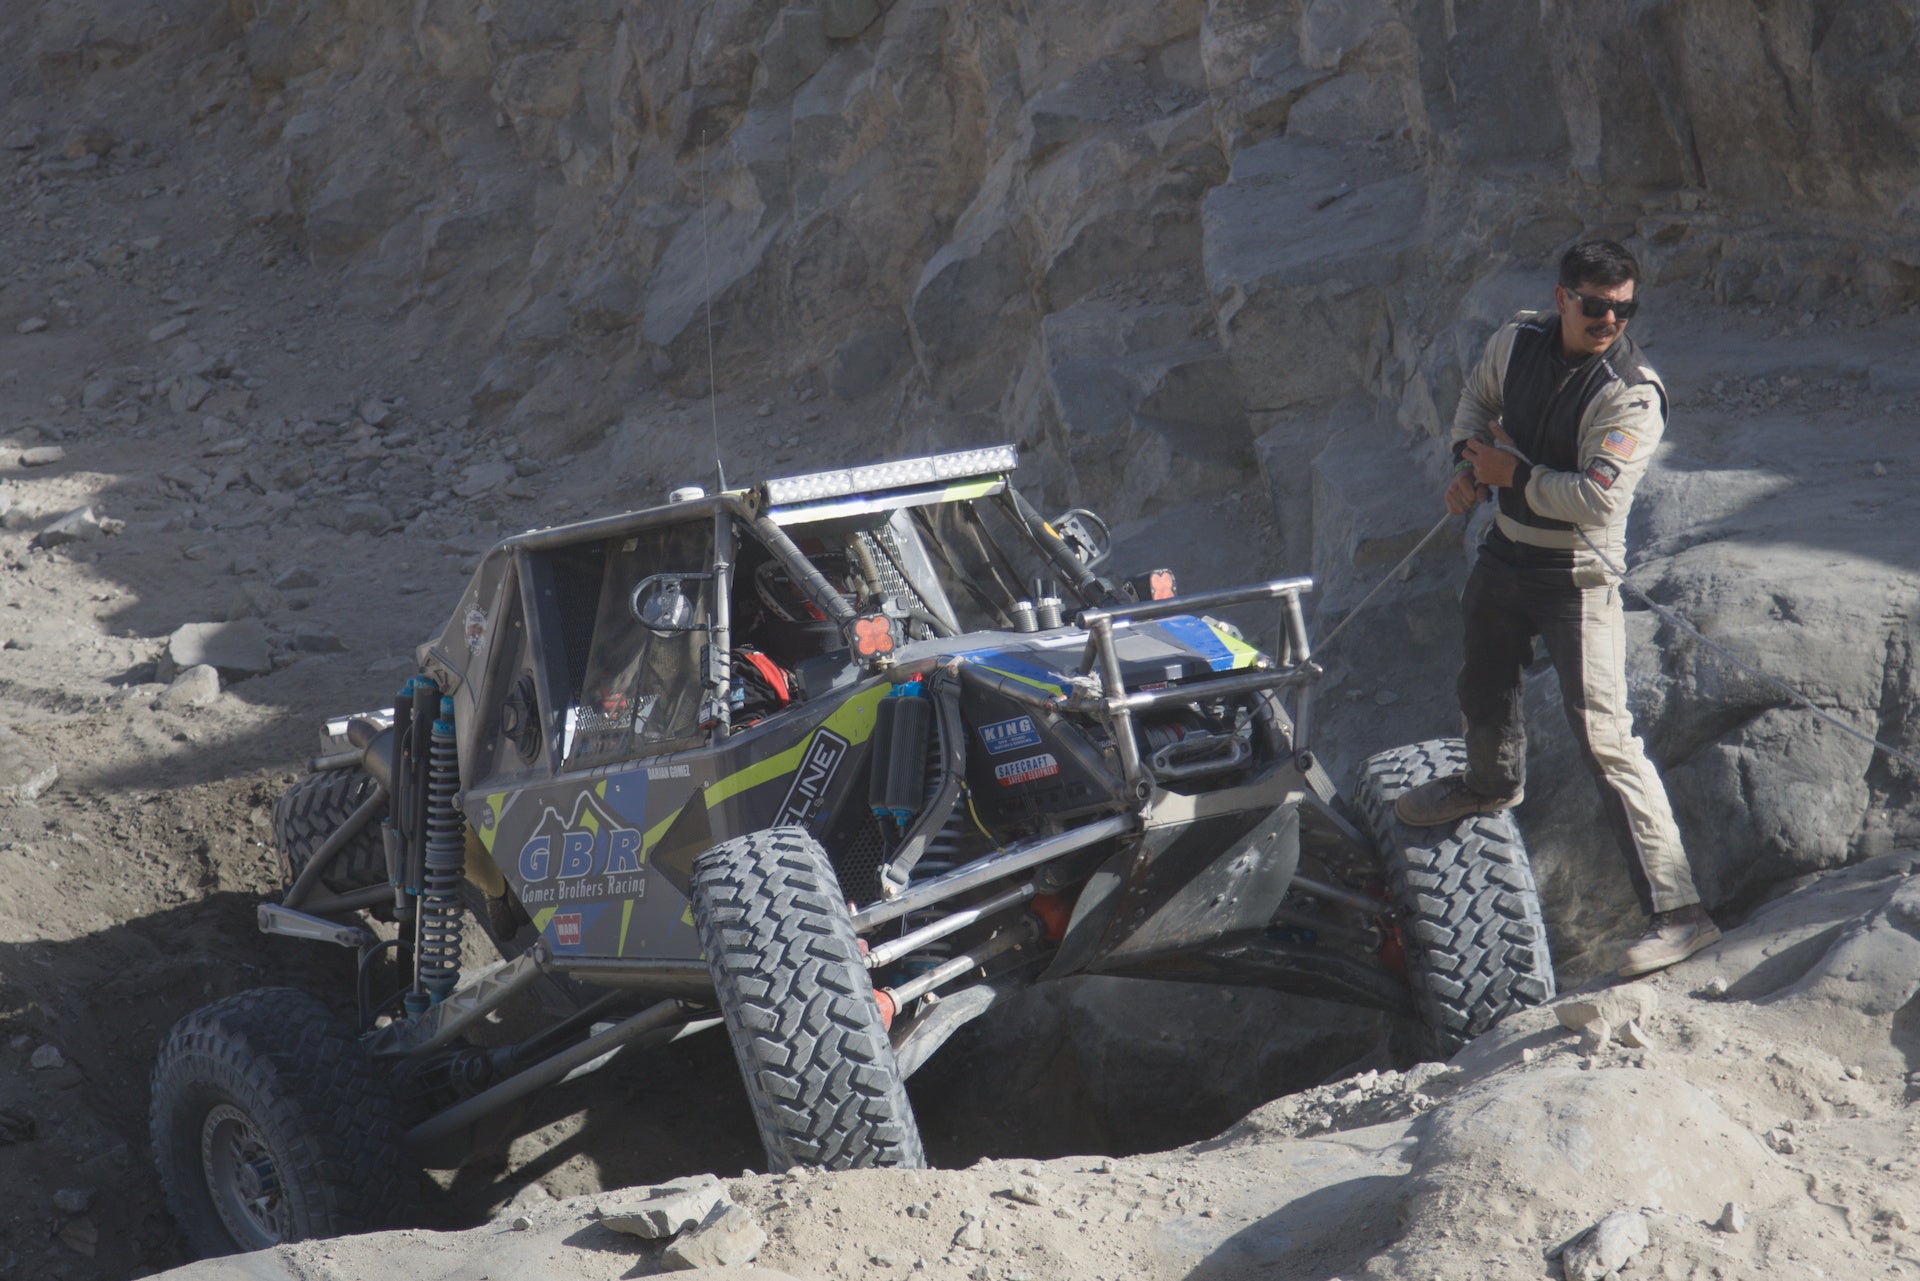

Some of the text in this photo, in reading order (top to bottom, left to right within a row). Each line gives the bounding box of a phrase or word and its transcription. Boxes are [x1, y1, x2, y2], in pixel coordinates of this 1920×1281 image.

[984, 719, 1031, 741] KING
[669, 764, 691, 778] GOMEZ
[998, 756, 1049, 778] SAFECRAFT
[1008, 765, 1058, 785] SAFETY EQUIPMENT
[518, 828, 644, 883] GBR
[522, 875, 646, 903] Gomez Brothers Racing
[557, 923, 579, 936] WARN
